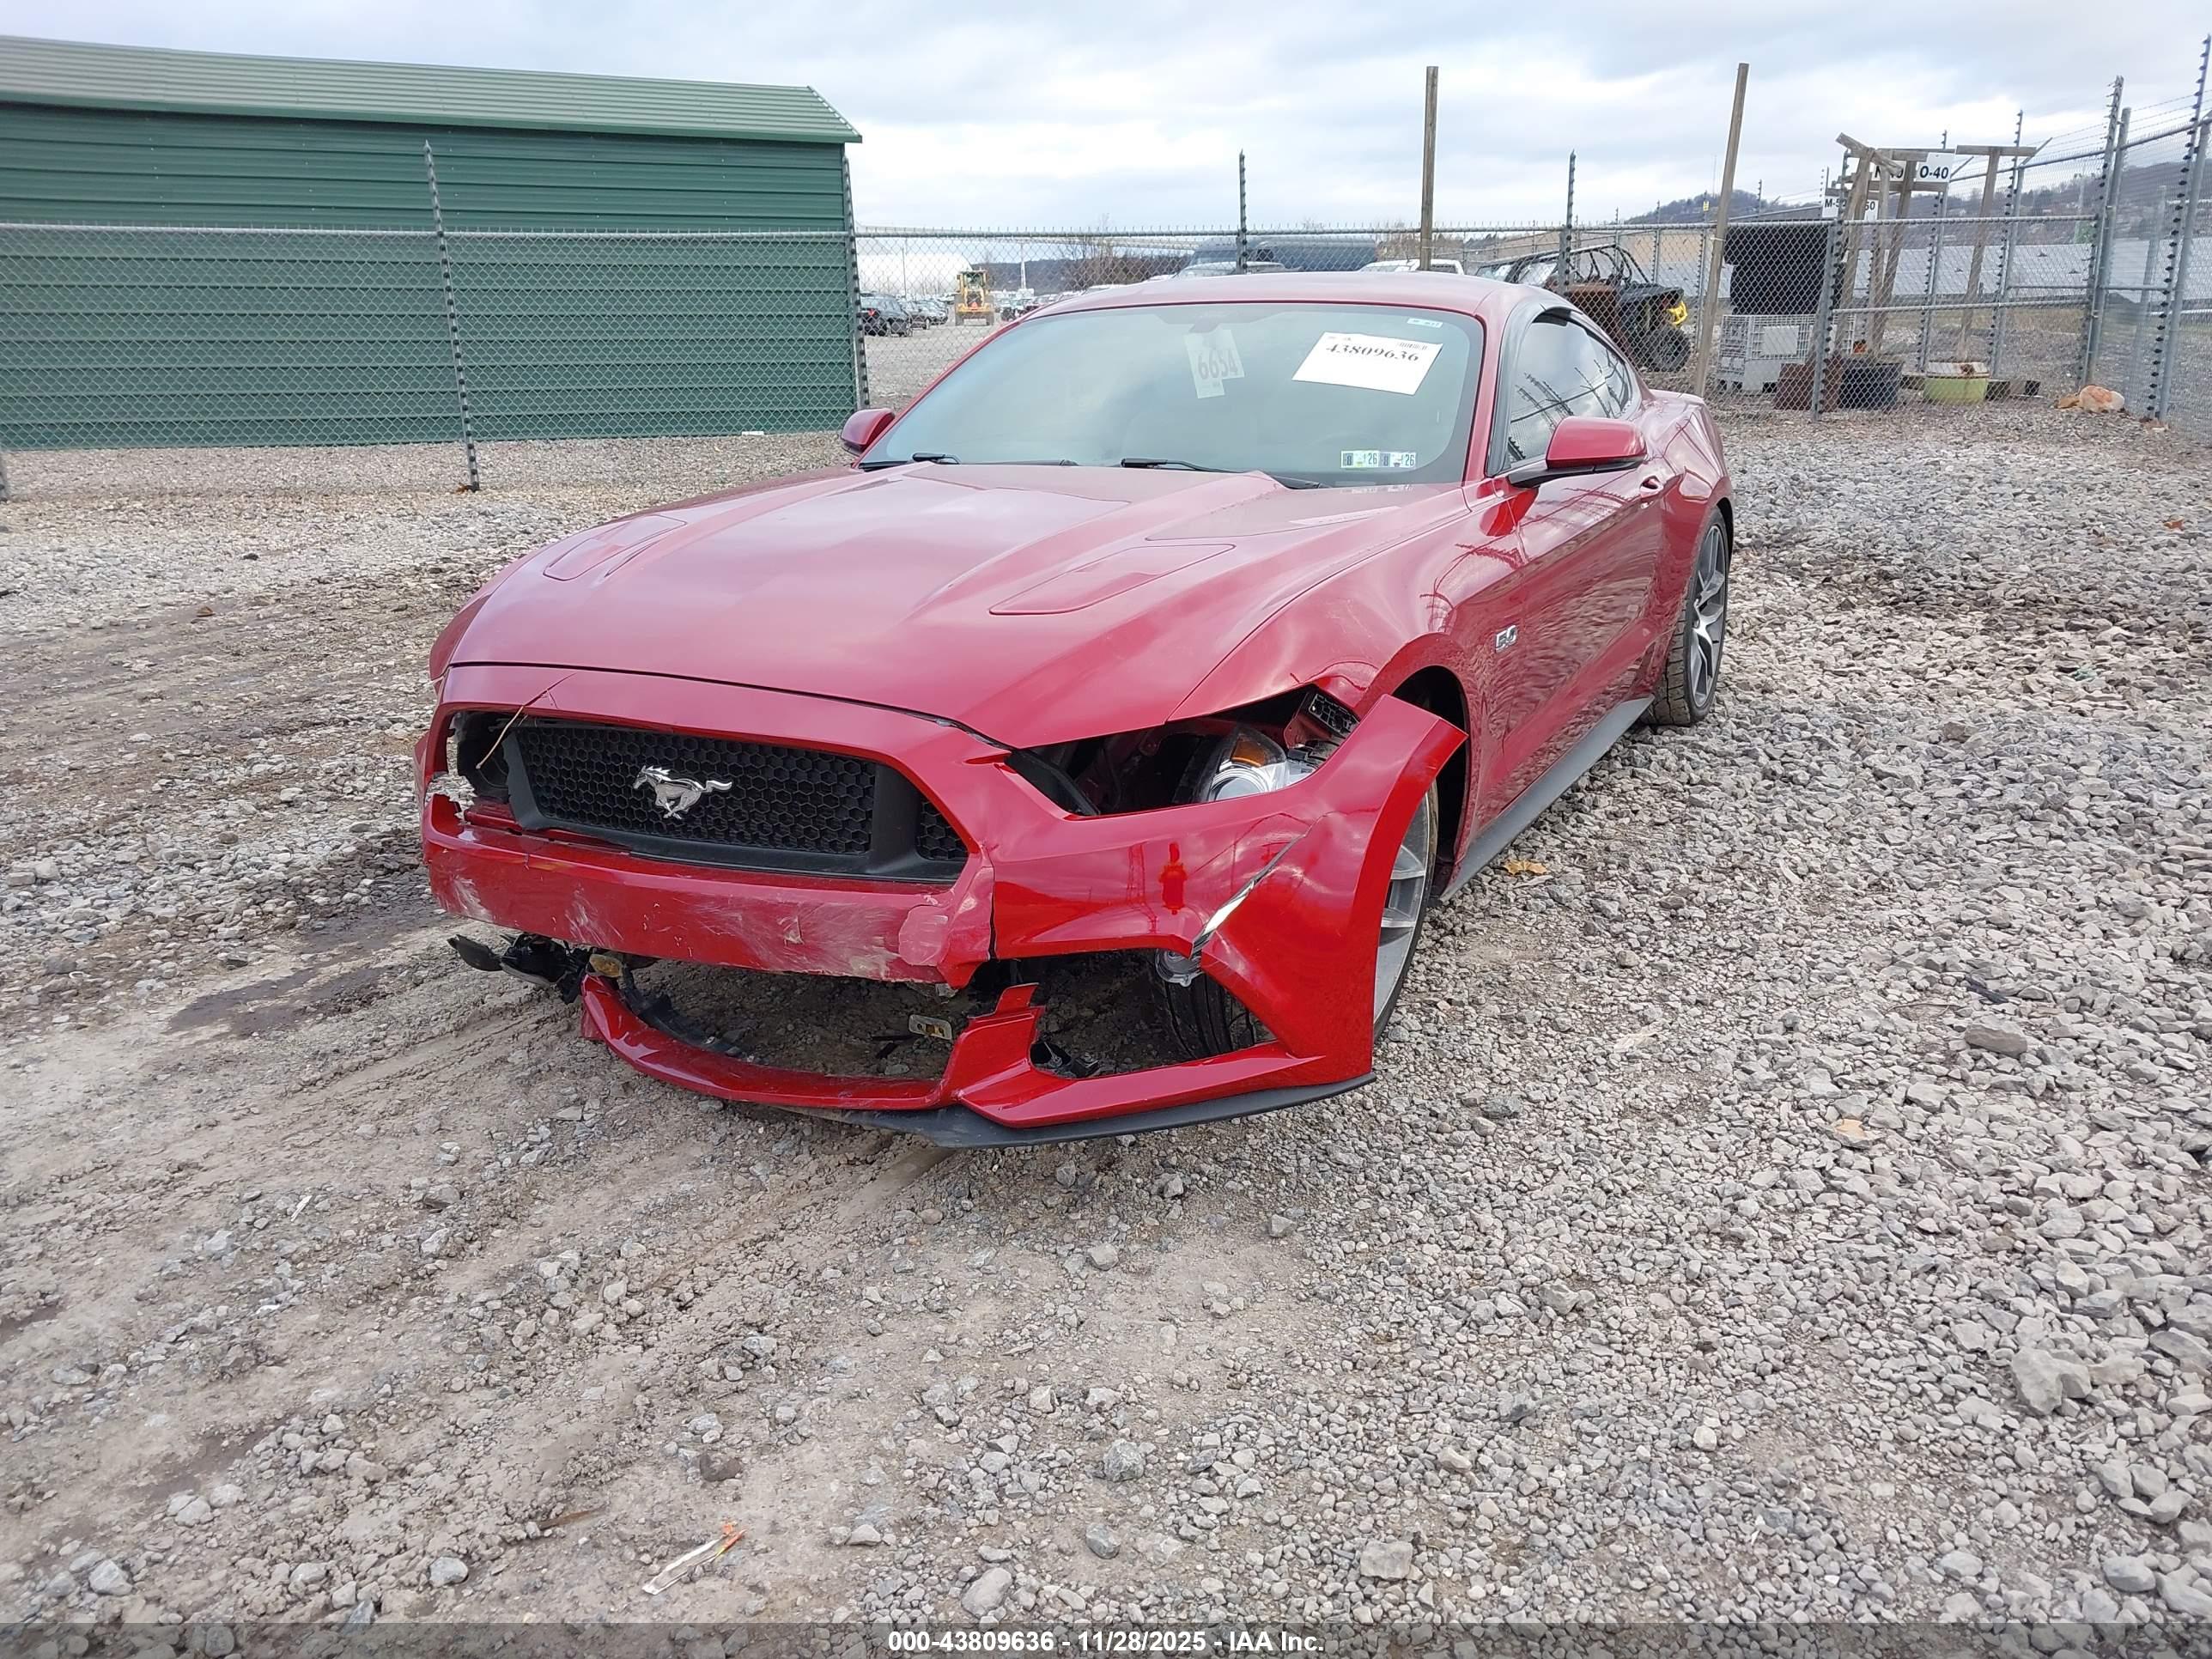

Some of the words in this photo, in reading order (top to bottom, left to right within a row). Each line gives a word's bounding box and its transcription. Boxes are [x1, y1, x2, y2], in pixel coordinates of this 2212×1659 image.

[1919, 165, 1949, 179] O-40
[1326, 343, 1419, 362] 43809636
[1197, 349, 1239, 380] 6654
[1368, 453, 1377, 465] 26
[1405, 453, 1414, 466] 26
